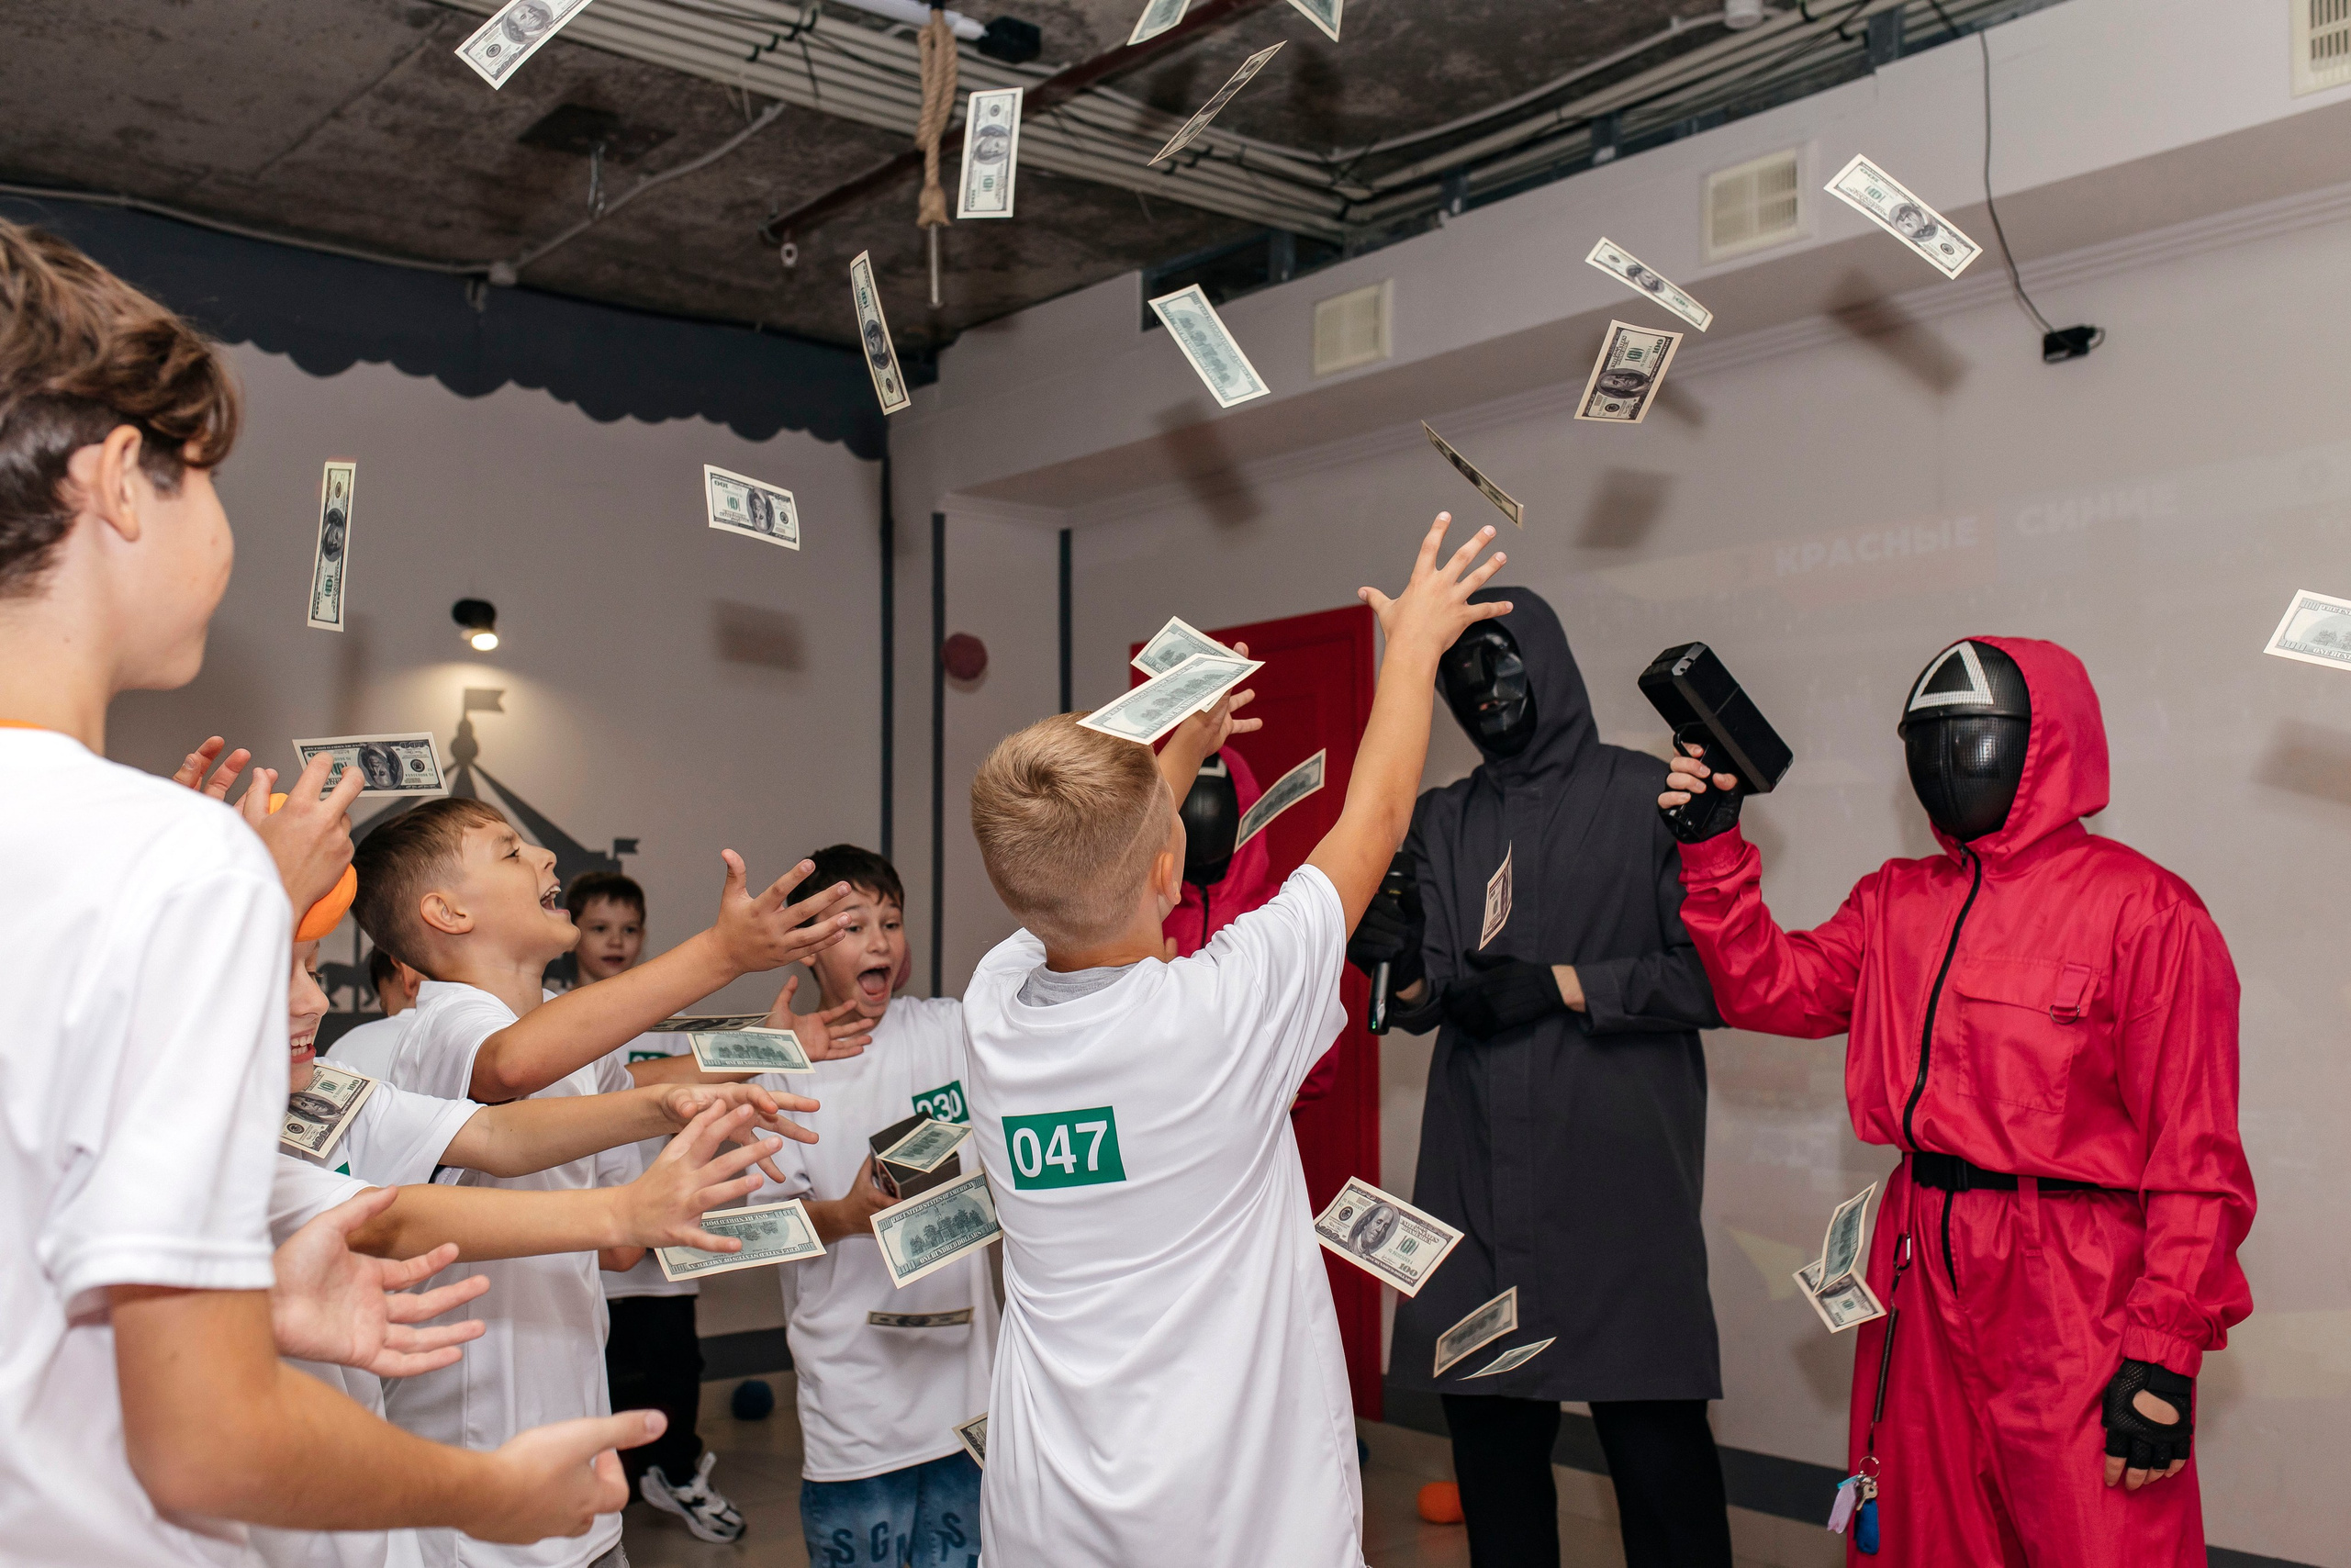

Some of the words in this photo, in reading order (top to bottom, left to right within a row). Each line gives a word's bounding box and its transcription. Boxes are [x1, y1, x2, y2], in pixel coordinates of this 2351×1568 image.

[1652, 338, 1663, 354] 100
[1774, 515, 1979, 577] КРАСНЫЕ
[2015, 481, 2178, 537] СИНИЕ
[347, 1080, 360, 1092] 100
[1013, 1120, 1107, 1178] 047
[919, 1253, 931, 1263] ONE
[931, 1240, 957, 1259] HUNDRED
[957, 1228, 981, 1246] DOLLARS
[1398, 1262, 1418, 1277] 100
